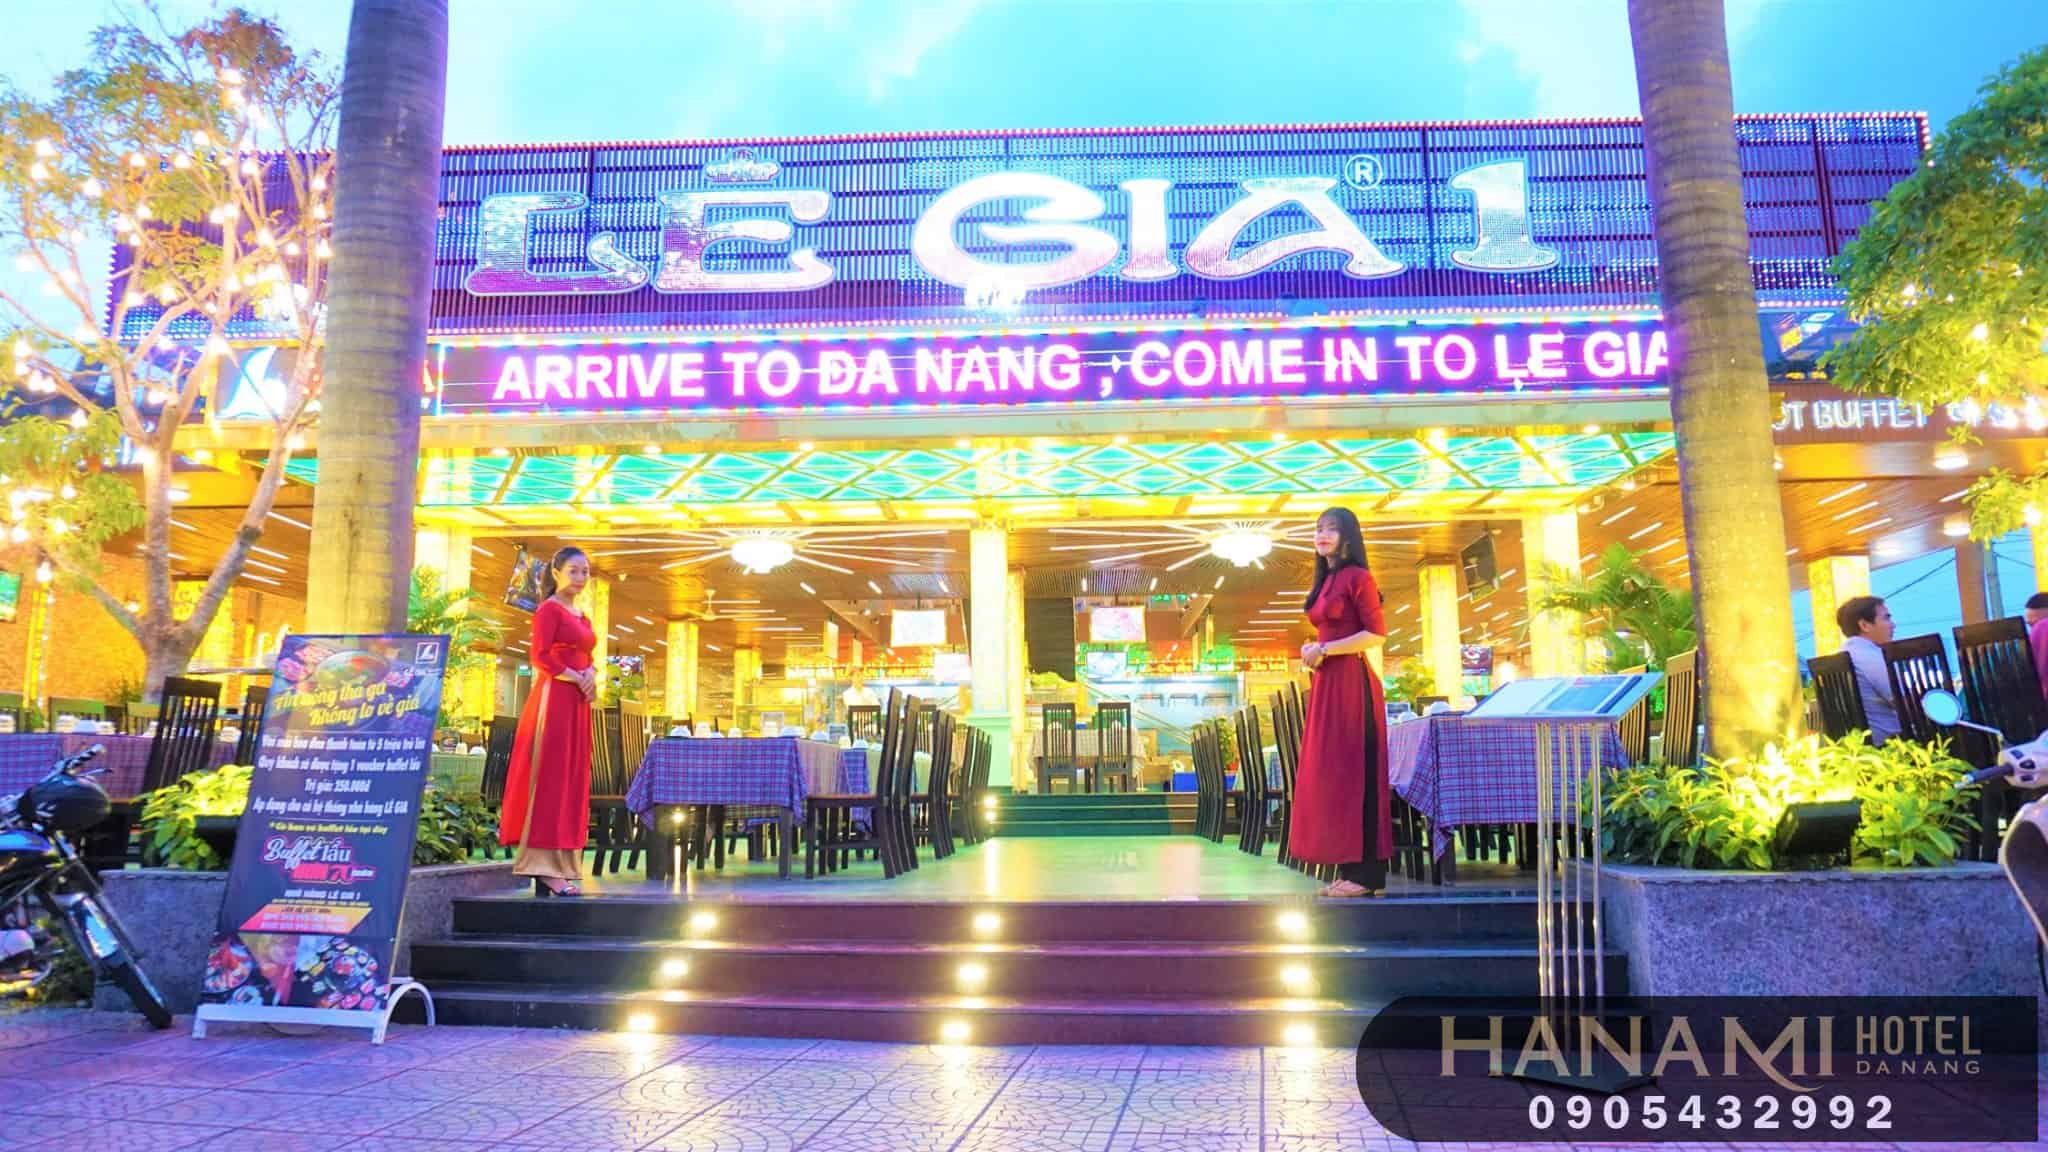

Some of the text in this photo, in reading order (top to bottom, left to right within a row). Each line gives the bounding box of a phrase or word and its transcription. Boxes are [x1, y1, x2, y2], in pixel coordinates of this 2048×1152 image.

[911, 169, 1411, 293] GIA
[1450, 158, 1560, 273] 1
[493, 353, 704, 400] ARRIVE
[722, 350, 800, 397] TO
[915, 343, 1081, 393] NANG
[1130, 338, 1306, 388] COME
[1323, 336, 1378, 383] IN
[1394, 333, 1476, 381] TO
[1495, 332, 1567, 379] LE
[1583, 328, 1668, 378] GIA
[1812, 399, 1928, 430] BUFFET
[264, 837, 322, 869] Buffet
